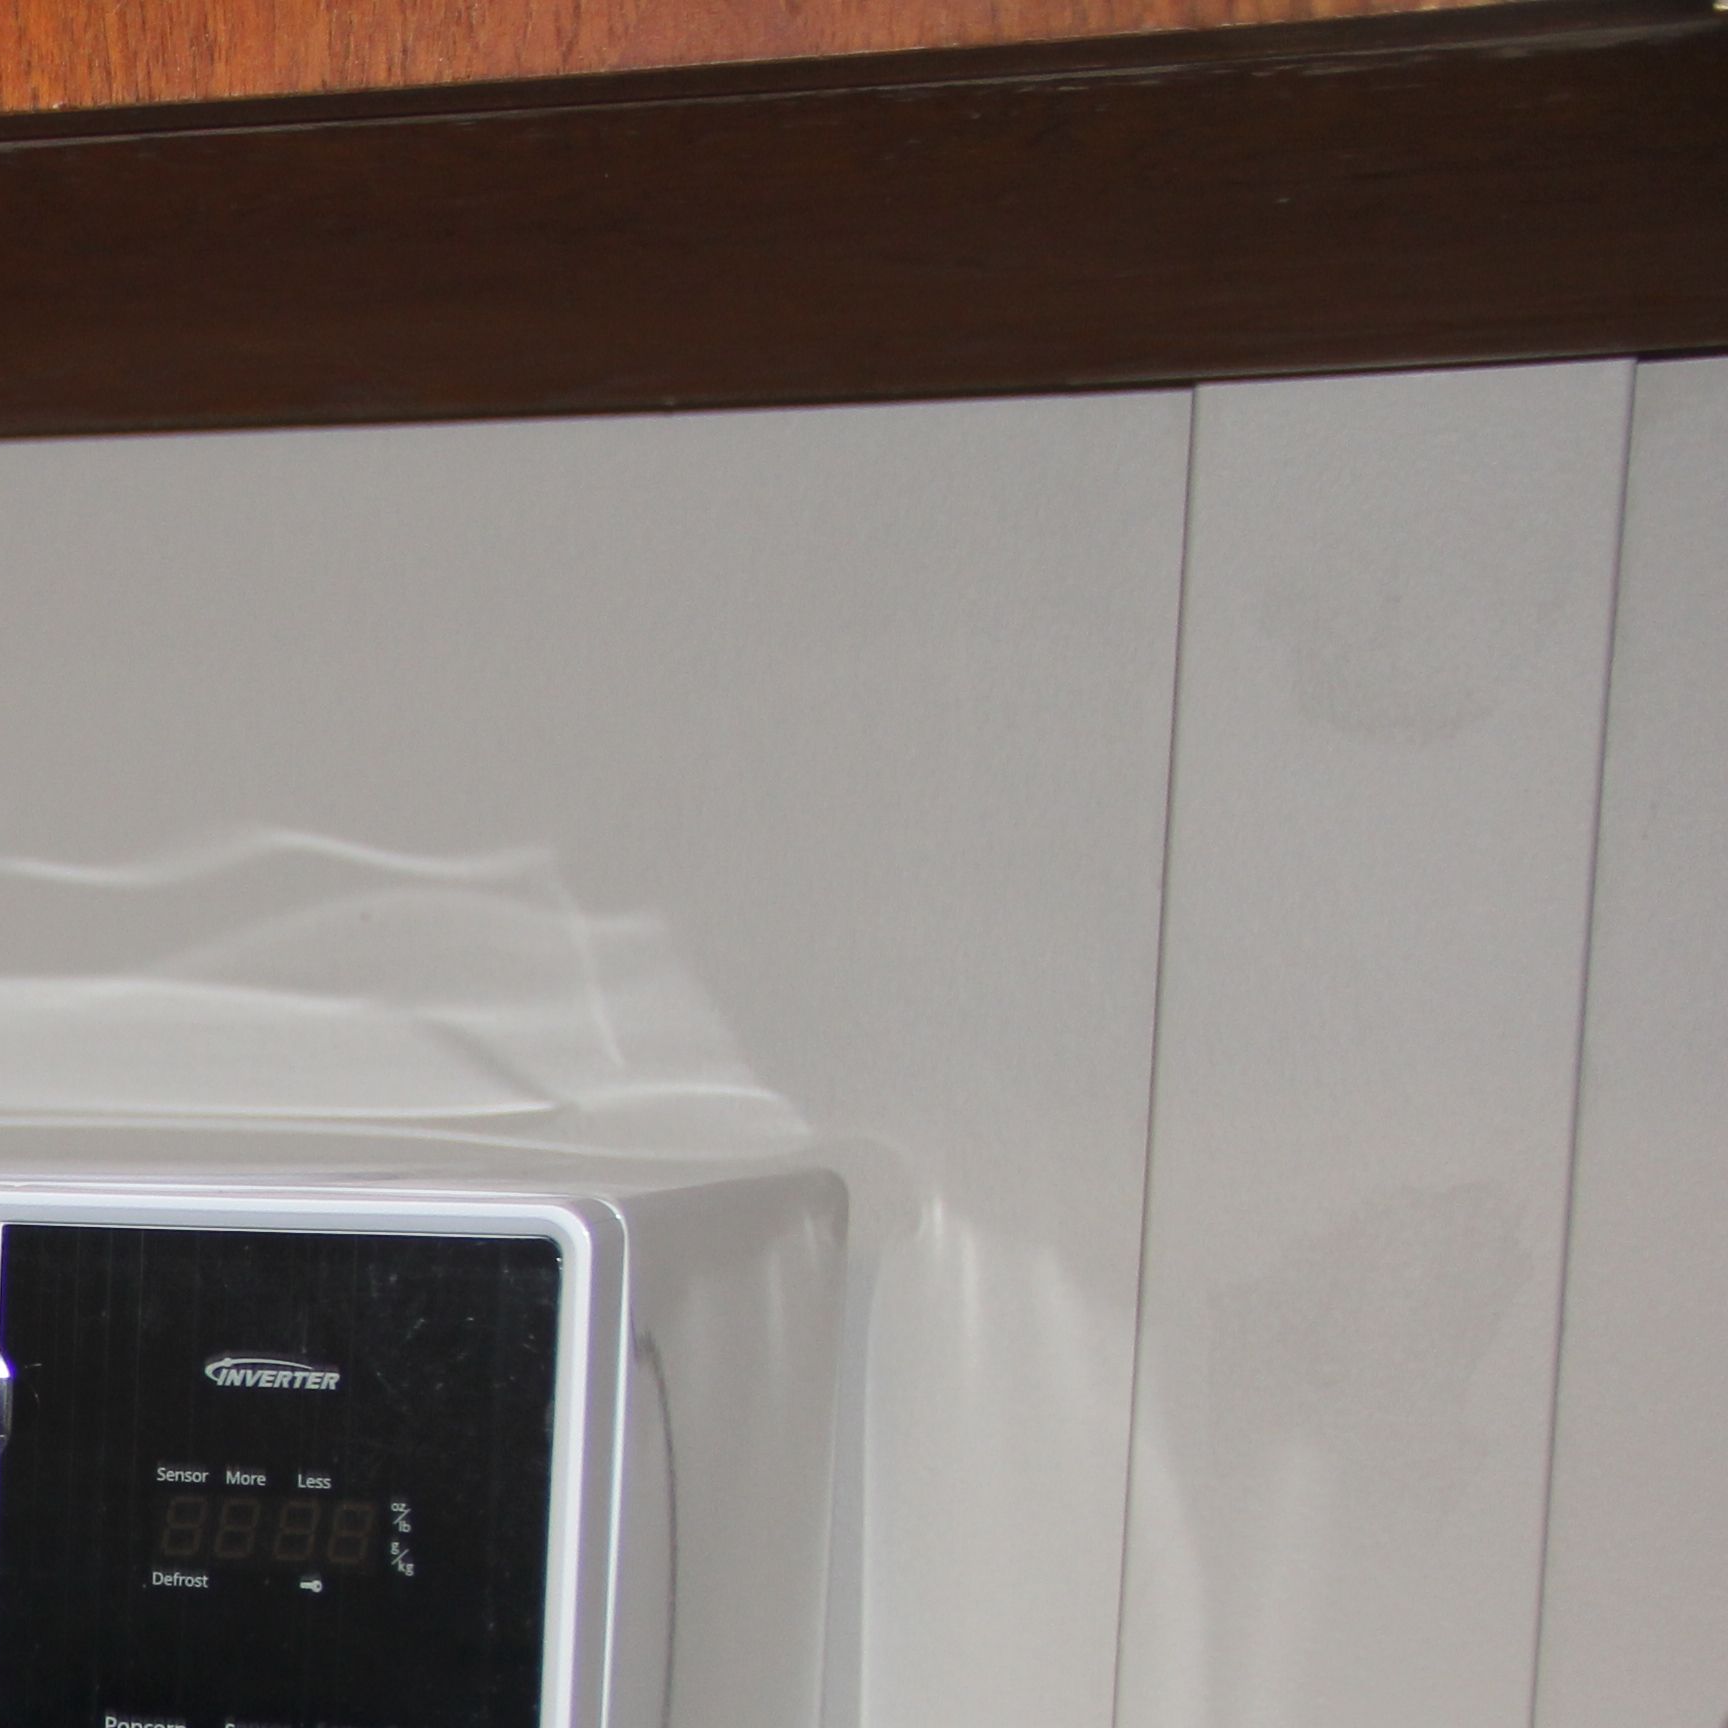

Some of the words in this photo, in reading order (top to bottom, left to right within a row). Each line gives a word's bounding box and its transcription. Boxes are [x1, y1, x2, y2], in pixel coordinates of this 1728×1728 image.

[214, 1368, 340, 1390] INVERTER
[156, 1468, 210, 1483] Sensor
[226, 1470, 266, 1487] More
[298, 1472, 332, 1489] Less
[152, 1571, 208, 1588] Defrost
